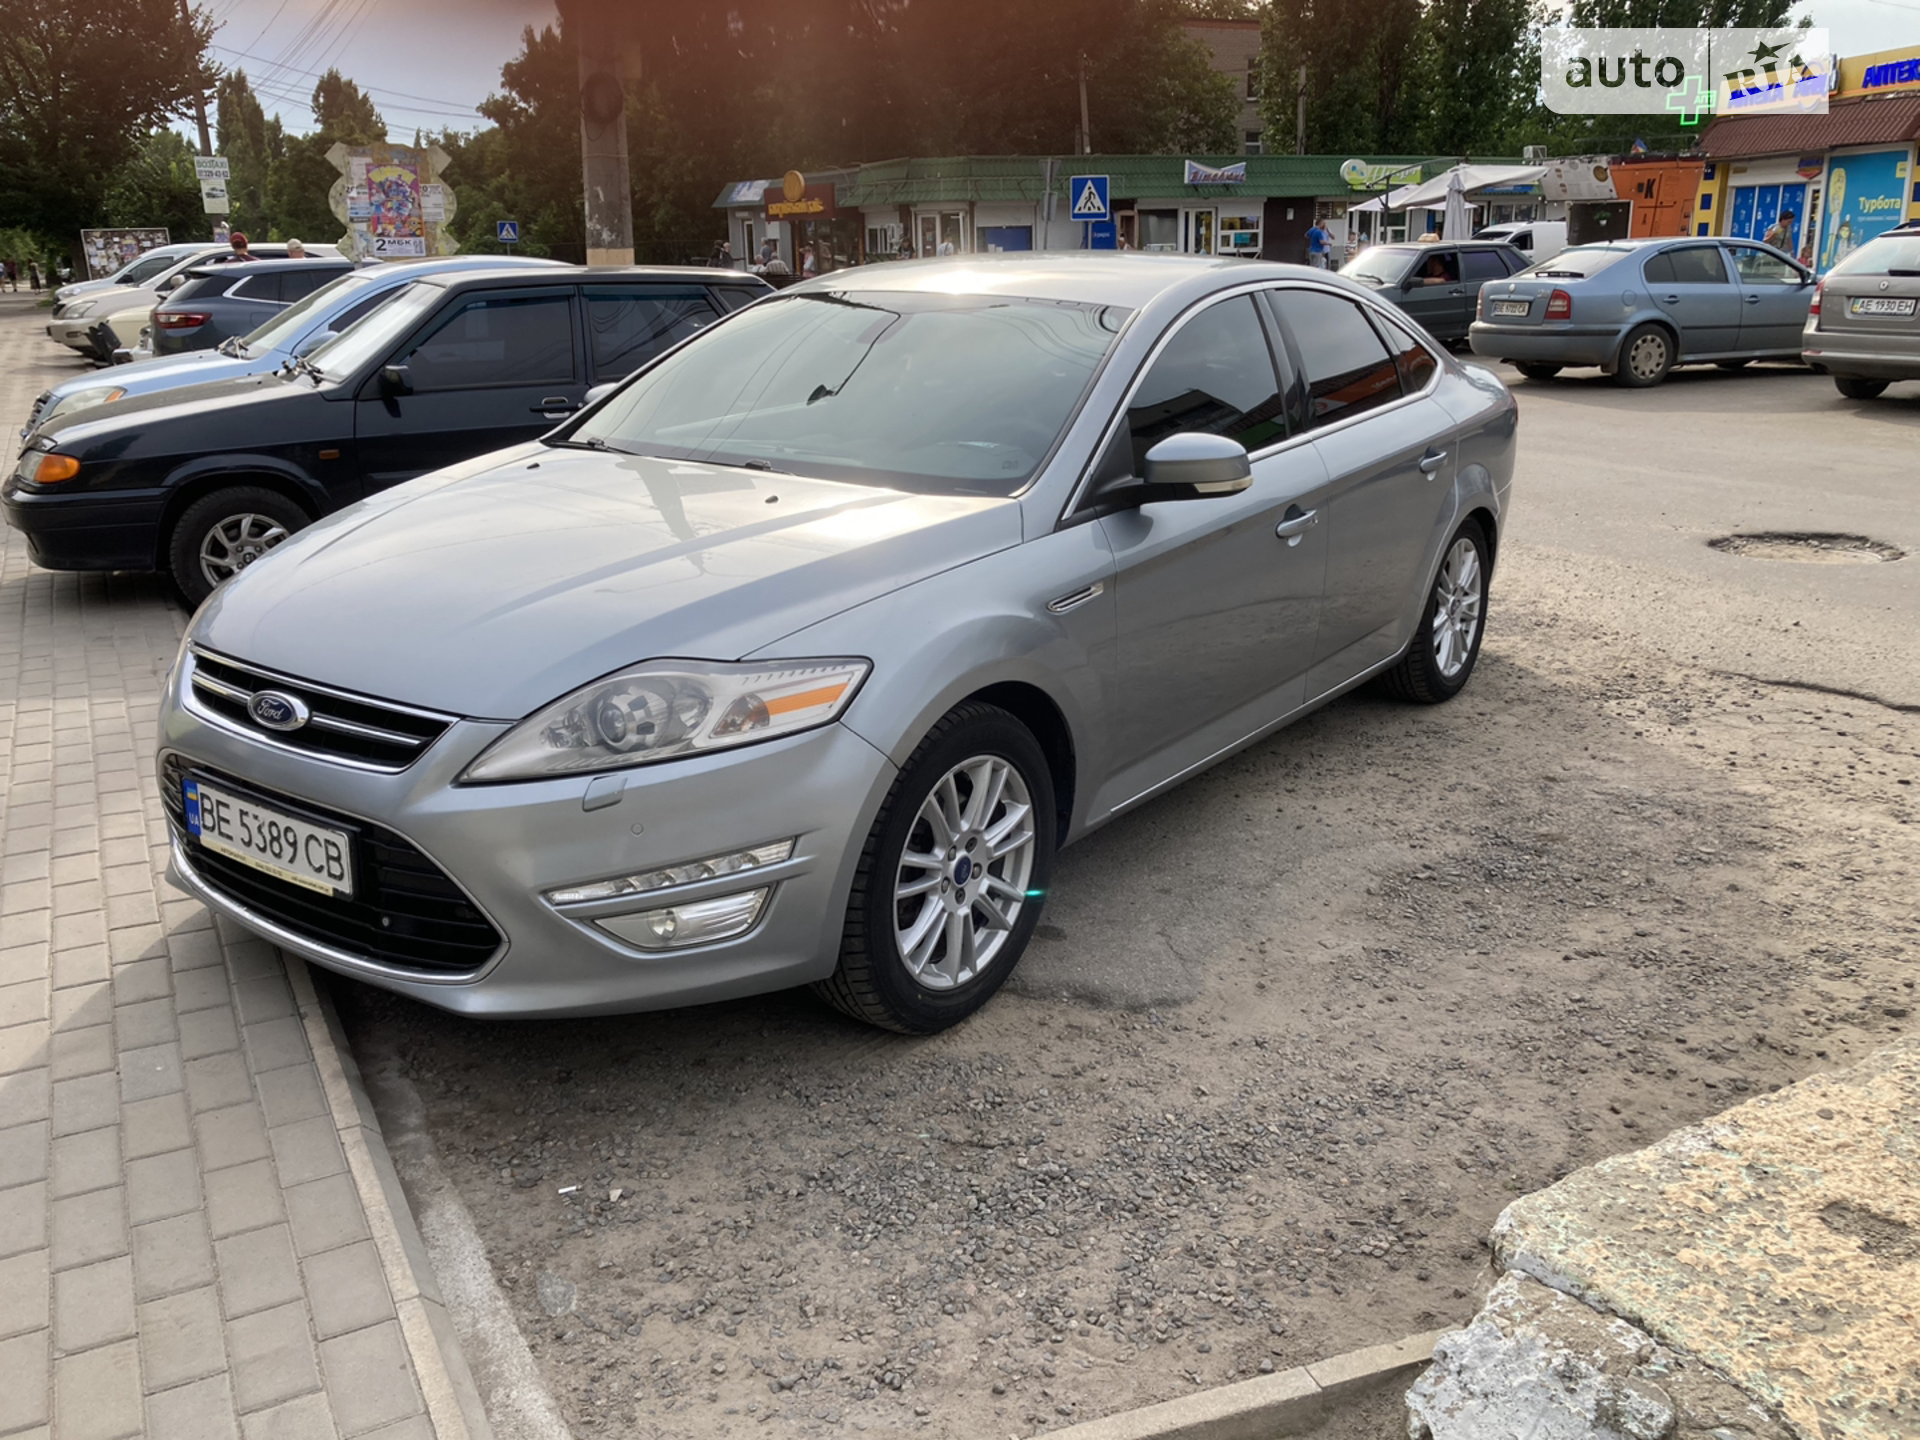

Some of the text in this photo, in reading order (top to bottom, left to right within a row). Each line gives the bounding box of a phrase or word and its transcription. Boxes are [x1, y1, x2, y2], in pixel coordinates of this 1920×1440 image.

[1858, 194, 1901, 213] Турбота
[375, 238, 387, 252] 2
[1897, 301, 1913, 312] EH
[257, 698, 285, 720] Ford
[188, 812, 200, 826] UA
[200, 792, 345, 882] BE 5389 CB
